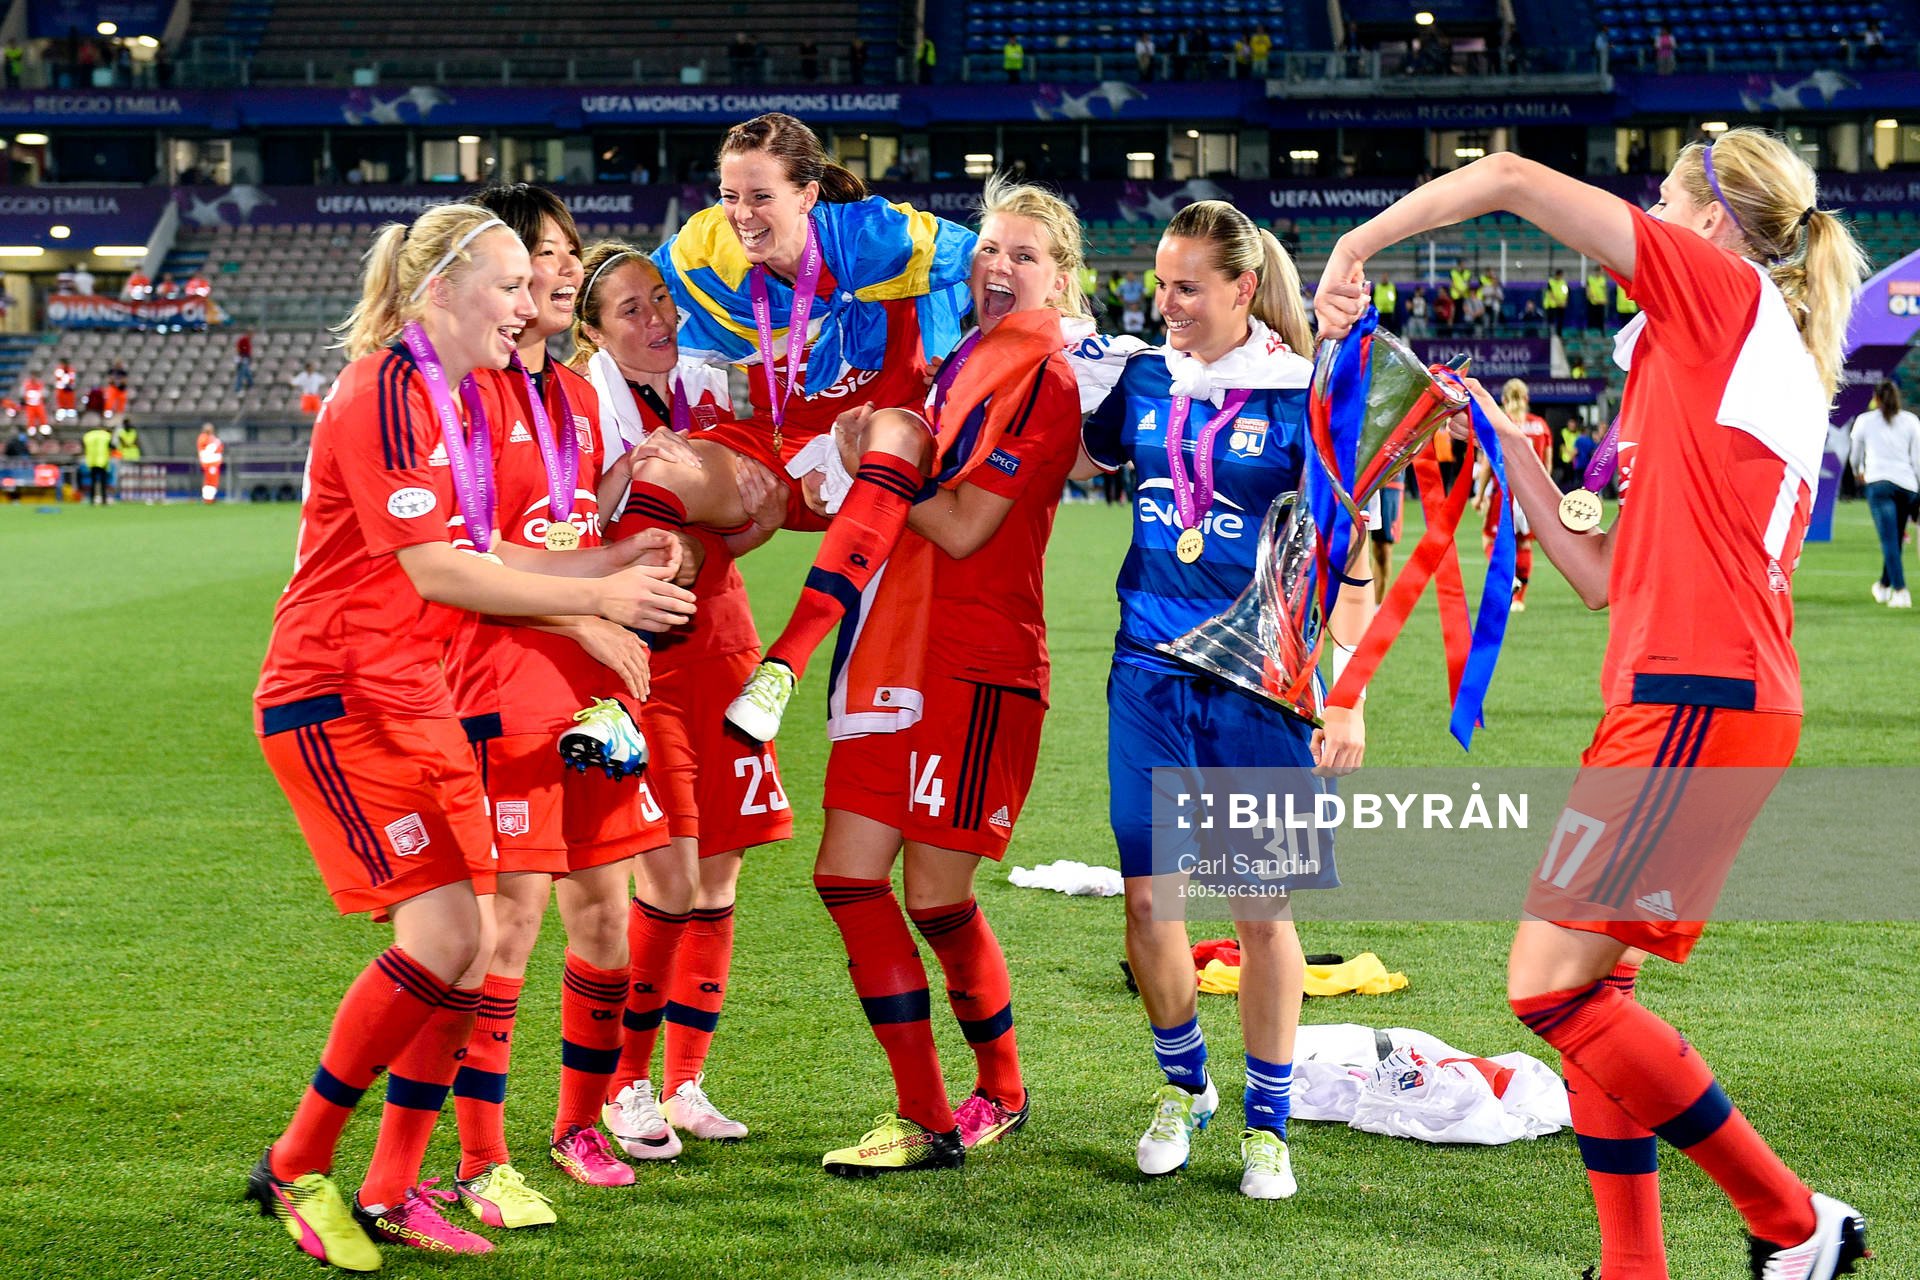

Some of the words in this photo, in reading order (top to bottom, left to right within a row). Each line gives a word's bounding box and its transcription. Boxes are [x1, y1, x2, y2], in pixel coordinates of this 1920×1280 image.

[115, 96, 182, 113] EMILIA
[582, 96, 629, 112] UEFA
[633, 95, 720, 112] WOMEN'S
[723, 94, 829, 111] CHAMPIONS
[832, 93, 900, 110] LEAGUE
[1417, 103, 1498, 119] REGGIO
[1503, 102, 1571, 117] EMILIA
[53, 196, 120, 214] EMILIA
[317, 196, 367, 213] UEFA
[566, 195, 633, 212] LEAGUE
[1270, 189, 1322, 207] UEFA
[804, 249, 816, 276] EMILIA
[756, 297, 767, 325] EMILIA
[1499, 345, 1531, 362] 2016
[1200, 429, 1212, 462] REGGIO
[1210, 410, 1231, 429] EMILIA
[990, 451, 1019, 471] SPECT
[551, 481, 564, 509] EMILIA
[1172, 455, 1183, 487] REGGIO
[1179, 488, 1187, 515] EMILIA
[734, 753, 789, 815] 23
[908, 751, 945, 817] 14
[1538, 807, 1607, 889] 17
